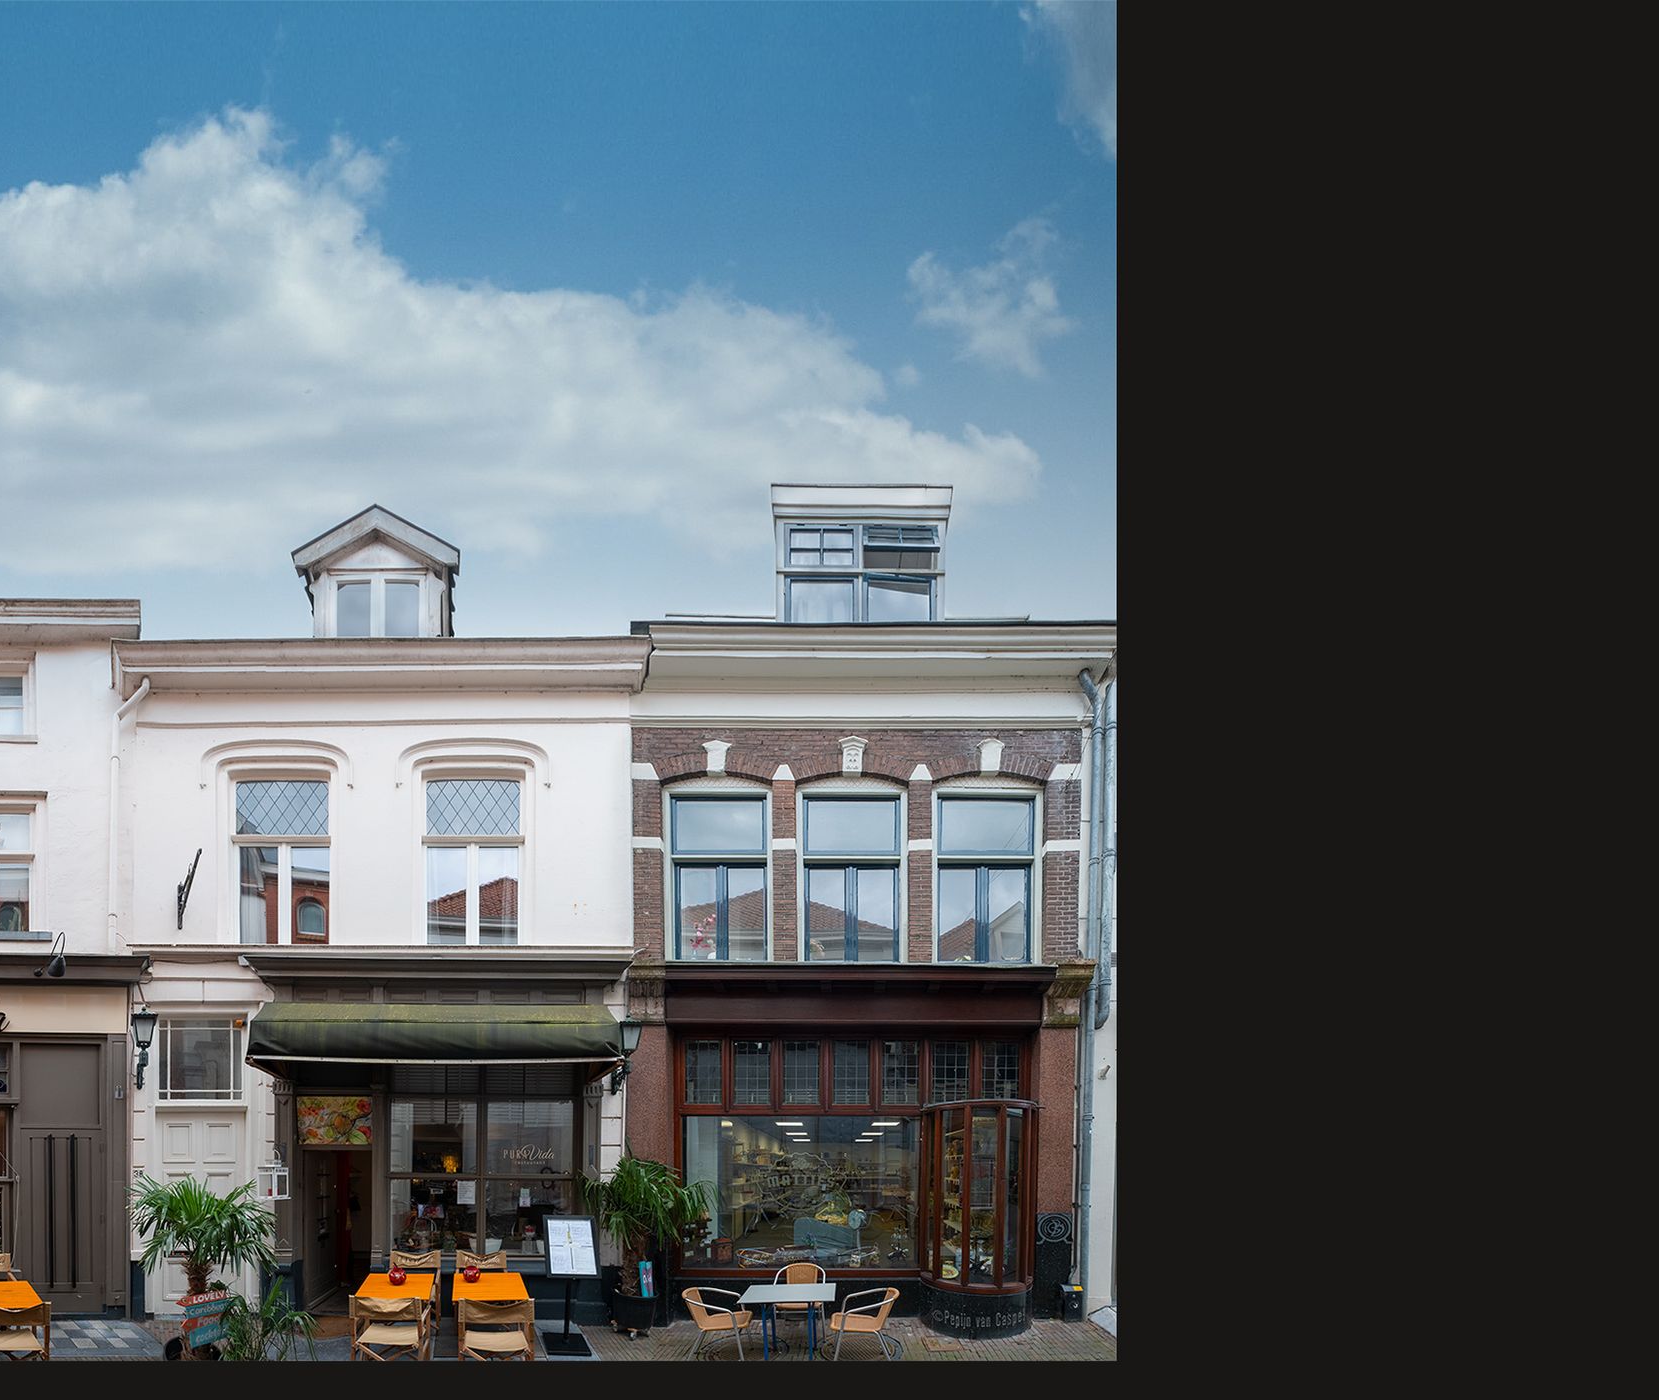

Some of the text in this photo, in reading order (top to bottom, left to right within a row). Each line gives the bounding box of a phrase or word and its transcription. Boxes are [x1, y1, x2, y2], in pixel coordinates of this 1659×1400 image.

[503, 1143, 555, 1161] PURA Vida
[193, 1290, 226, 1304] LOVELY
